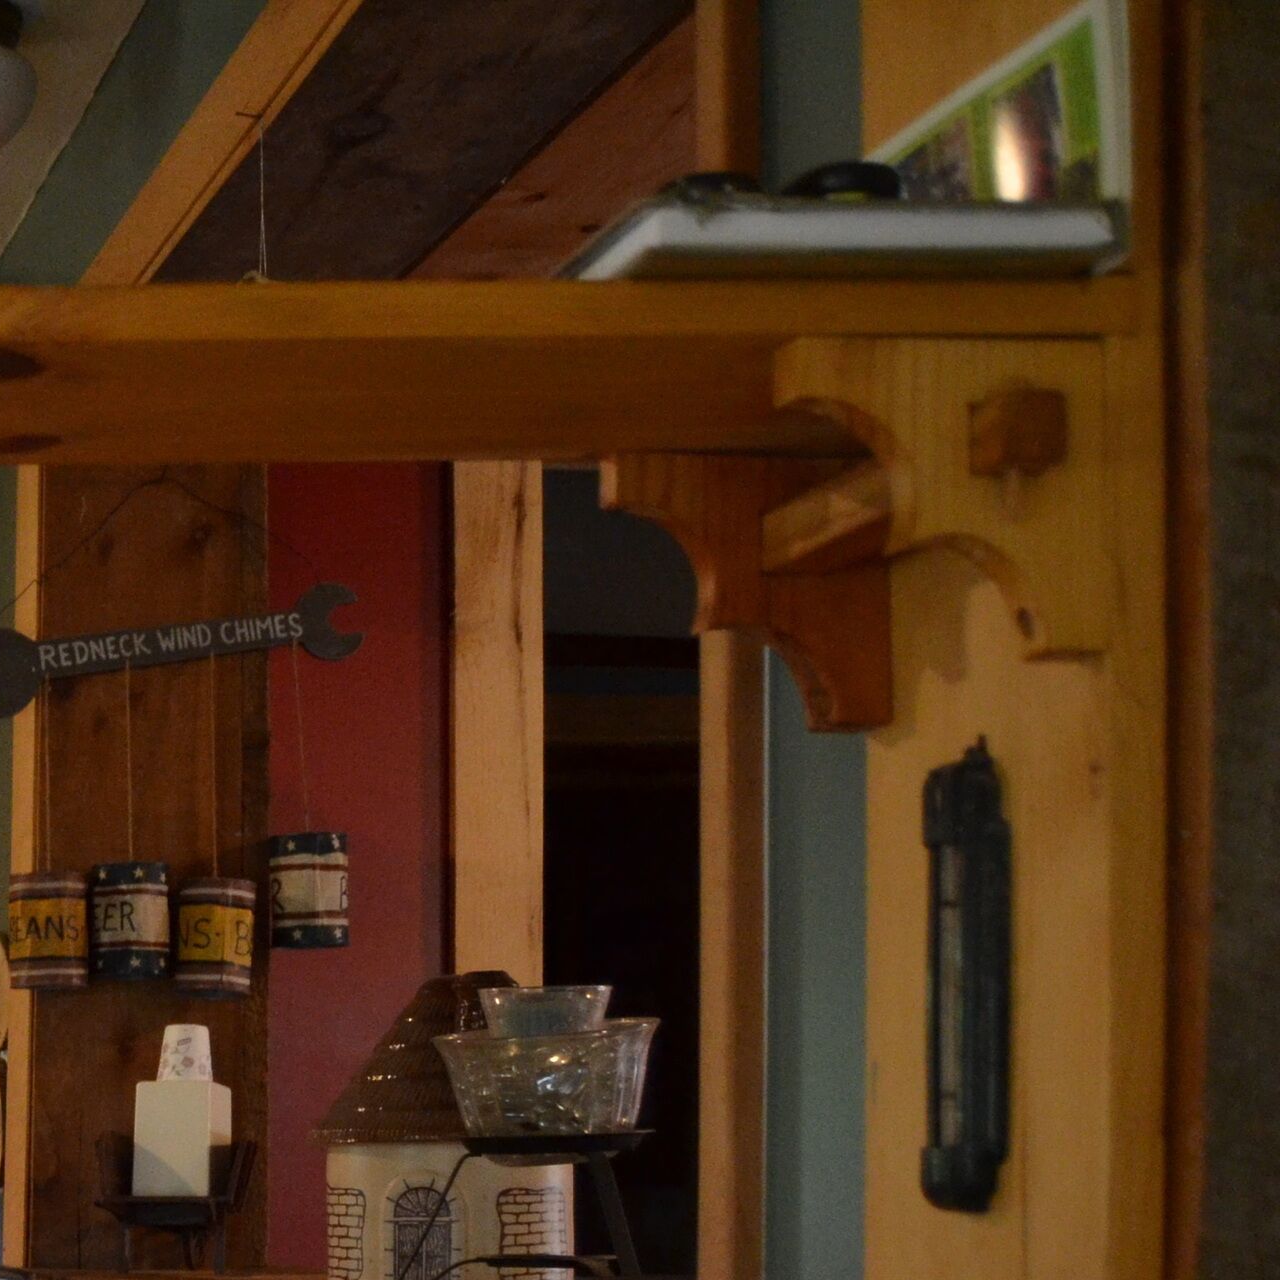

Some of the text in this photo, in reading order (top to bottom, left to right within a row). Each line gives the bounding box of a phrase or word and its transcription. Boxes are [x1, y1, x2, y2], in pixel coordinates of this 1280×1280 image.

[38, 613, 303, 671] REDNECK WIND CHIMES
